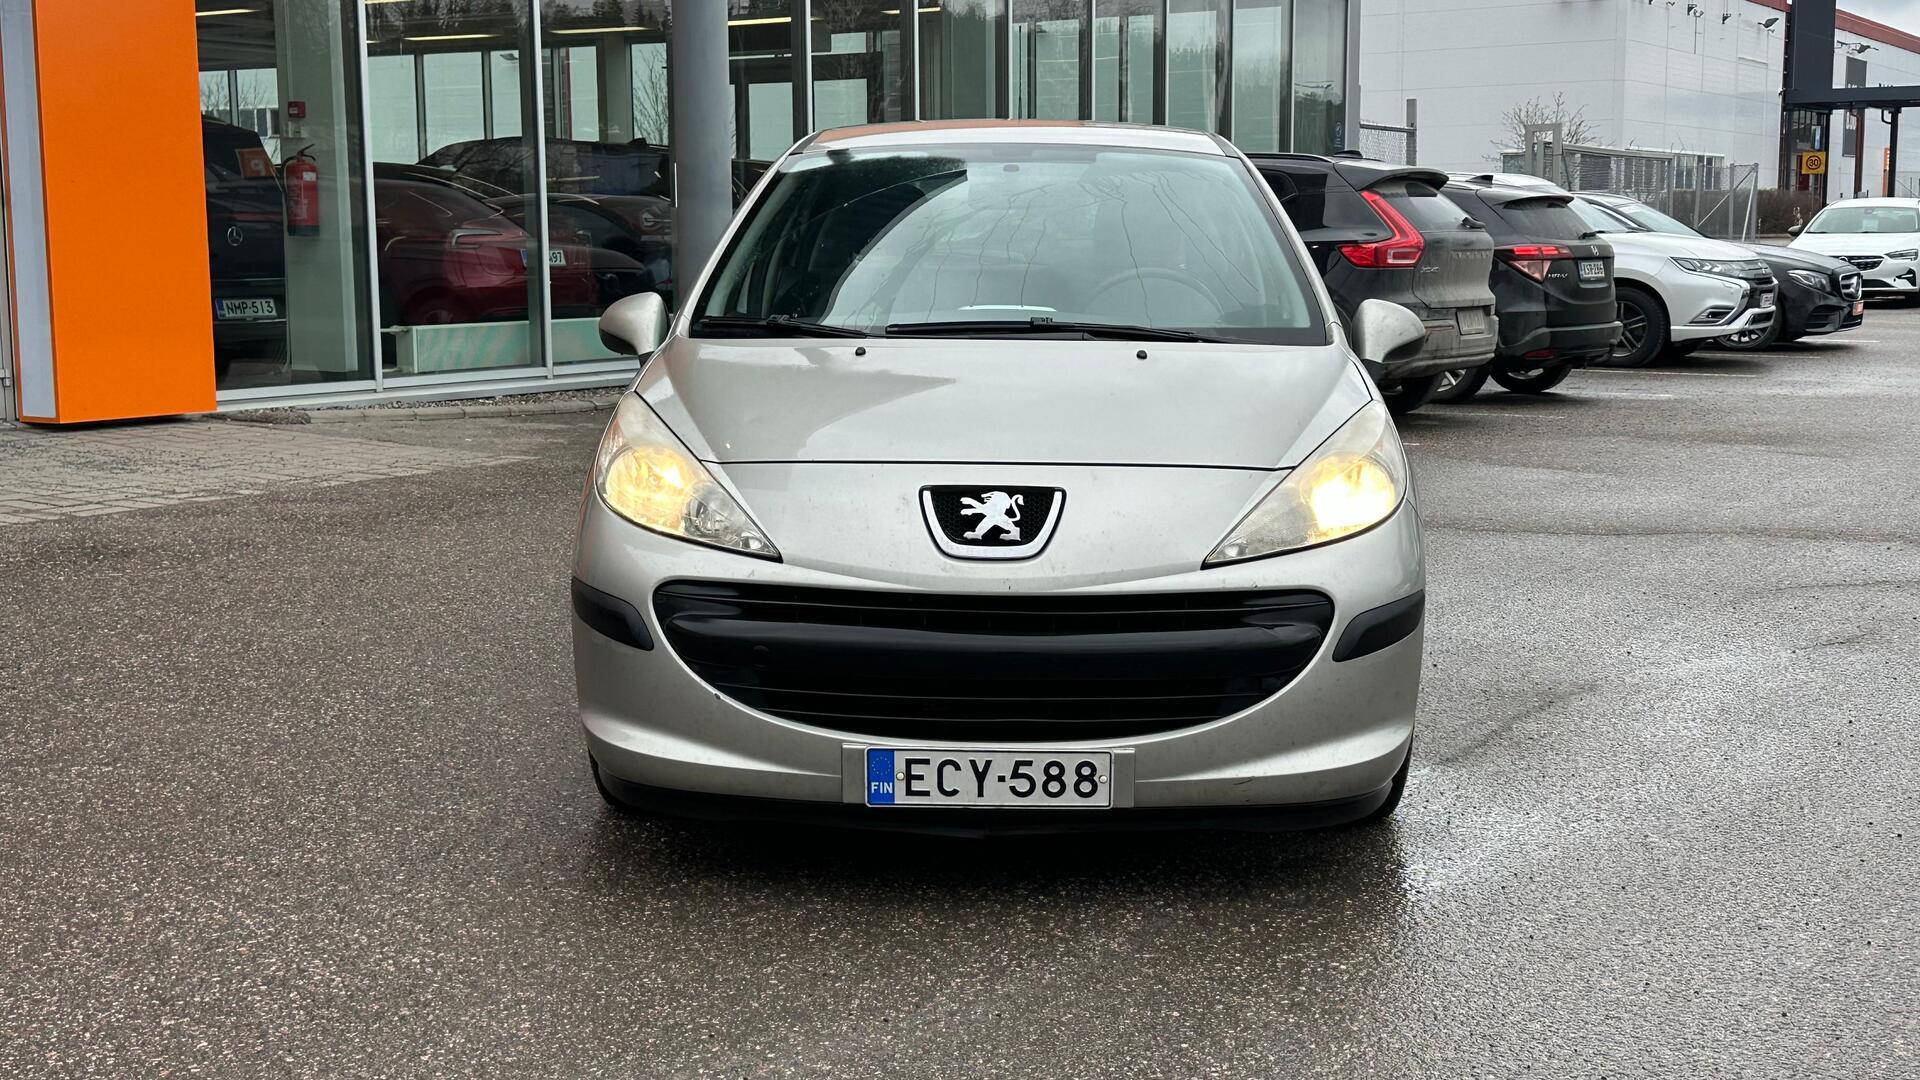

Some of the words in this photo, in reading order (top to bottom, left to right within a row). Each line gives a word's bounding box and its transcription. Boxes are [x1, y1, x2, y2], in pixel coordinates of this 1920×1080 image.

[1809, 159, 1818, 167] 30
[225, 301, 274, 315] NMP-513
[871, 781, 893, 794] FIN
[904, 758, 1099, 799] ECY-588
